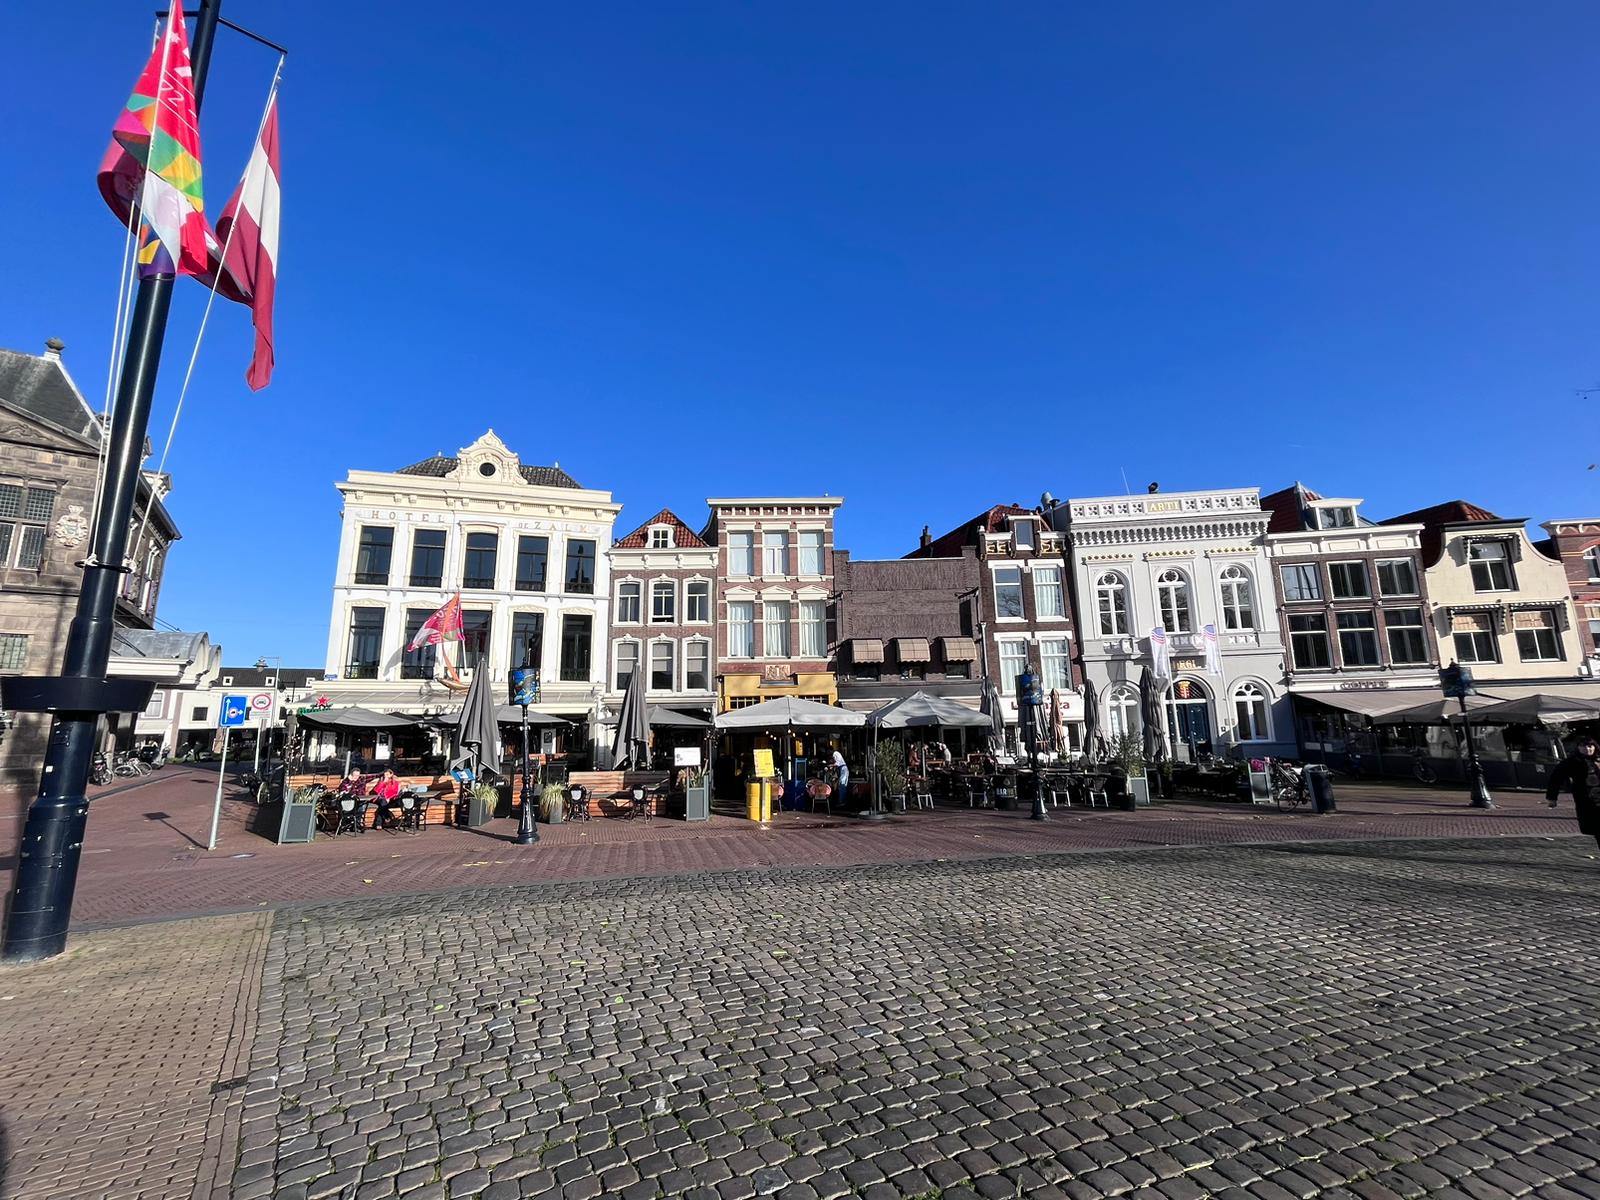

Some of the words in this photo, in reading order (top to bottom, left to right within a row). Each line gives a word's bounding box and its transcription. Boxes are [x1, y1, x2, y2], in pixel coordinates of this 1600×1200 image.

[1150, 501, 1179, 511] ARTI
[371, 510, 446, 523] HOTEL
[534, 521, 588, 533] ZALM
